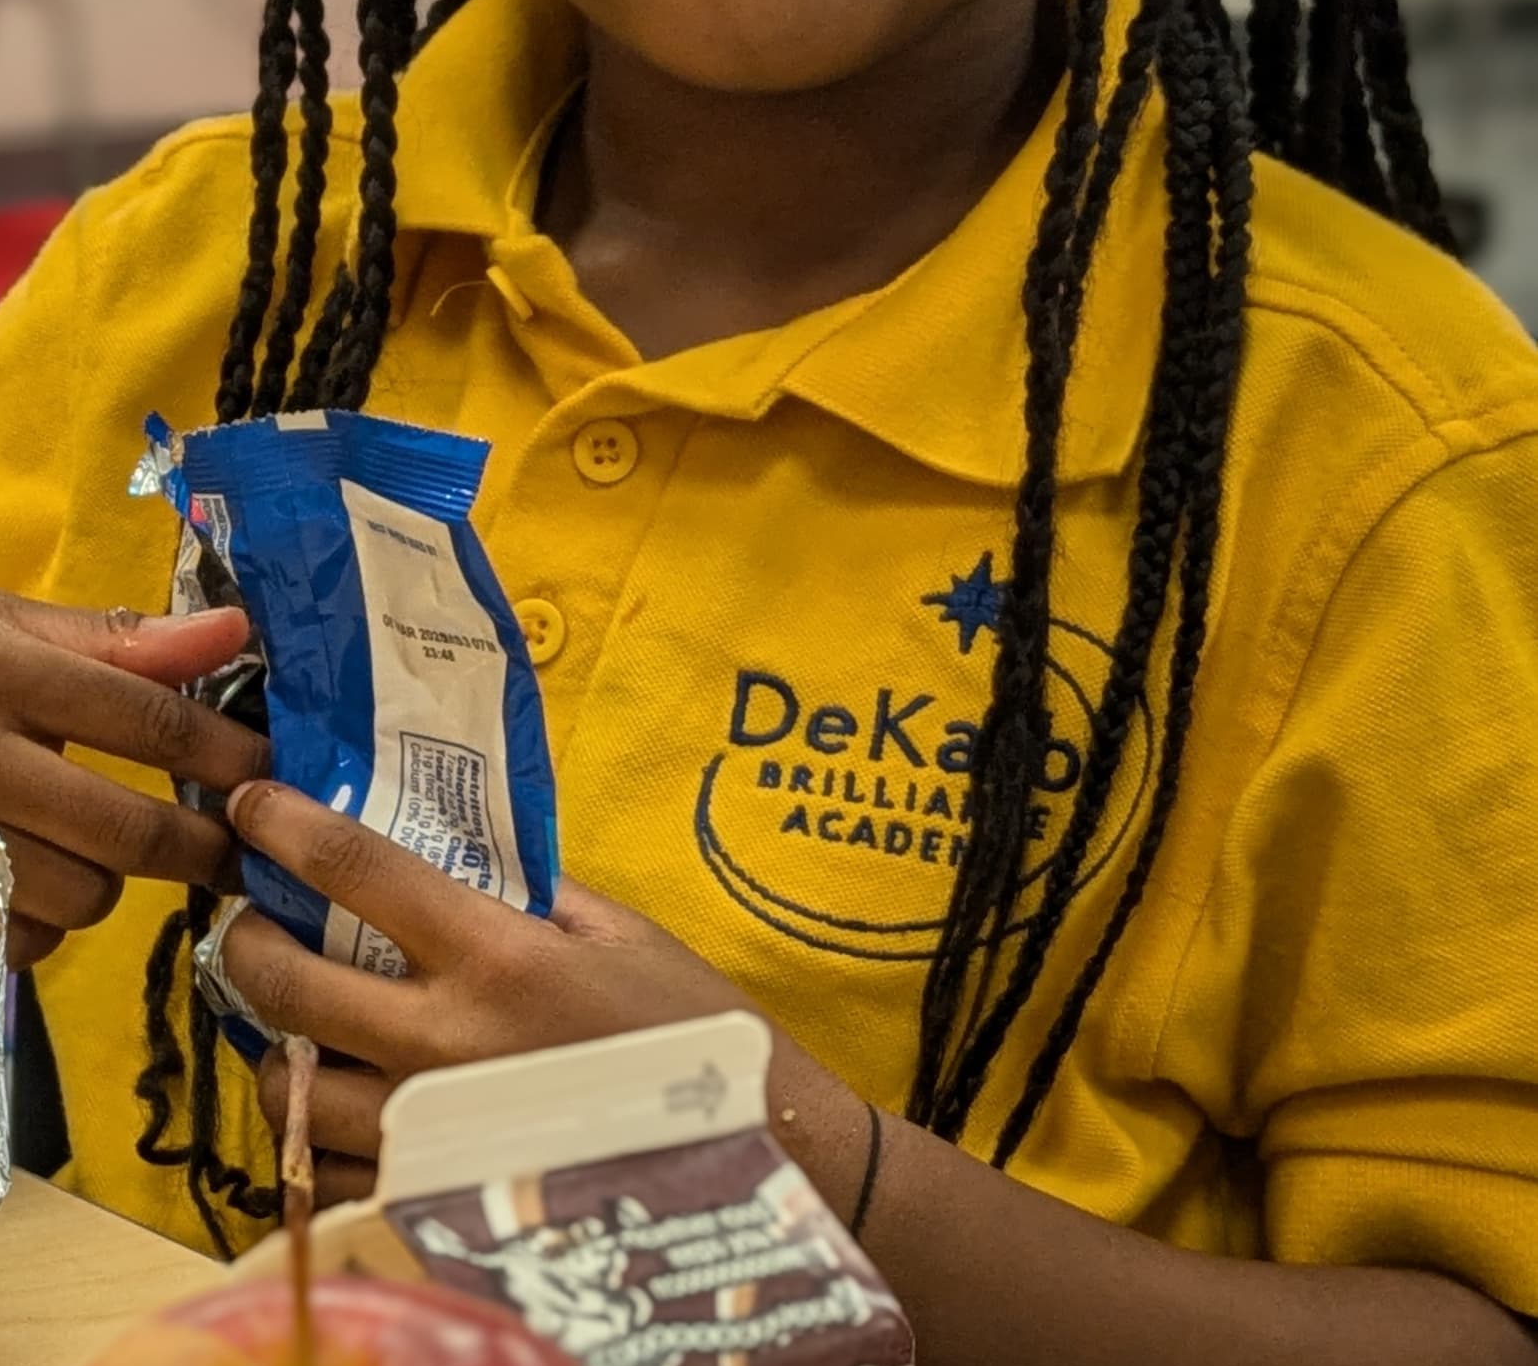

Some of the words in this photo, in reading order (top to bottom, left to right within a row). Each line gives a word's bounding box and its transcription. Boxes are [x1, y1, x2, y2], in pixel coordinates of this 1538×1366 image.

[410, 742, 422, 794] Calcium
[435, 749, 446, 784] Total
[456, 754, 469, 823] Calories
[470, 758, 484, 838] Nutrition
[757, 759, 1051, 840] BRILLIAE
[399, 826, 415, 849] DV
[442, 836, 462, 875] Chole
[780, 804, 967, 867] ACADE
